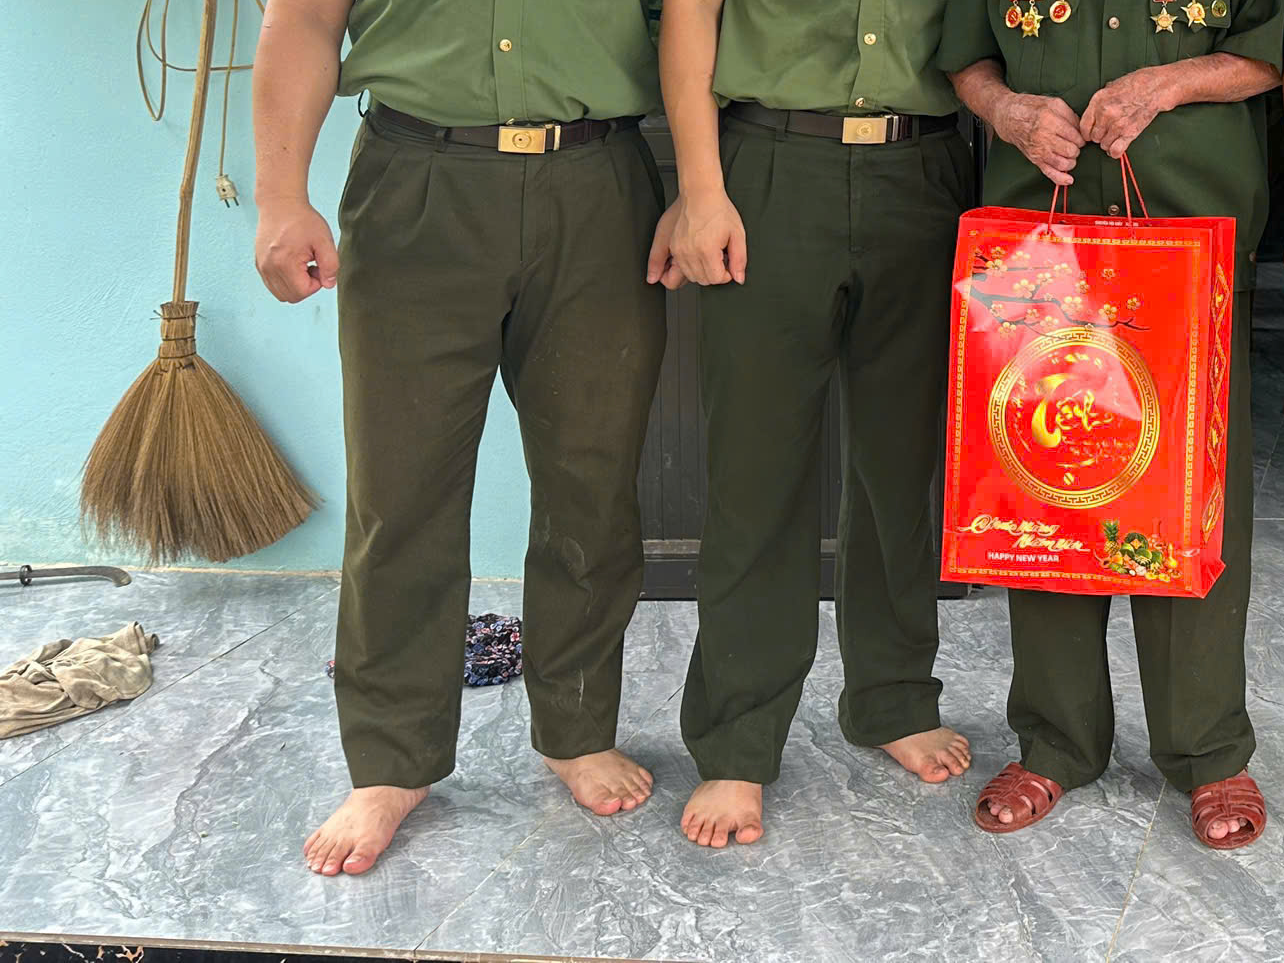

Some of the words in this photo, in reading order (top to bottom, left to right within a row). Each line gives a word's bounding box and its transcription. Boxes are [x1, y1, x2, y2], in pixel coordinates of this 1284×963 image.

[987, 551, 1015, 562] HAPPY
[1015, 553, 1036, 562] NEW
[1037, 554, 1060, 563] YEAR
